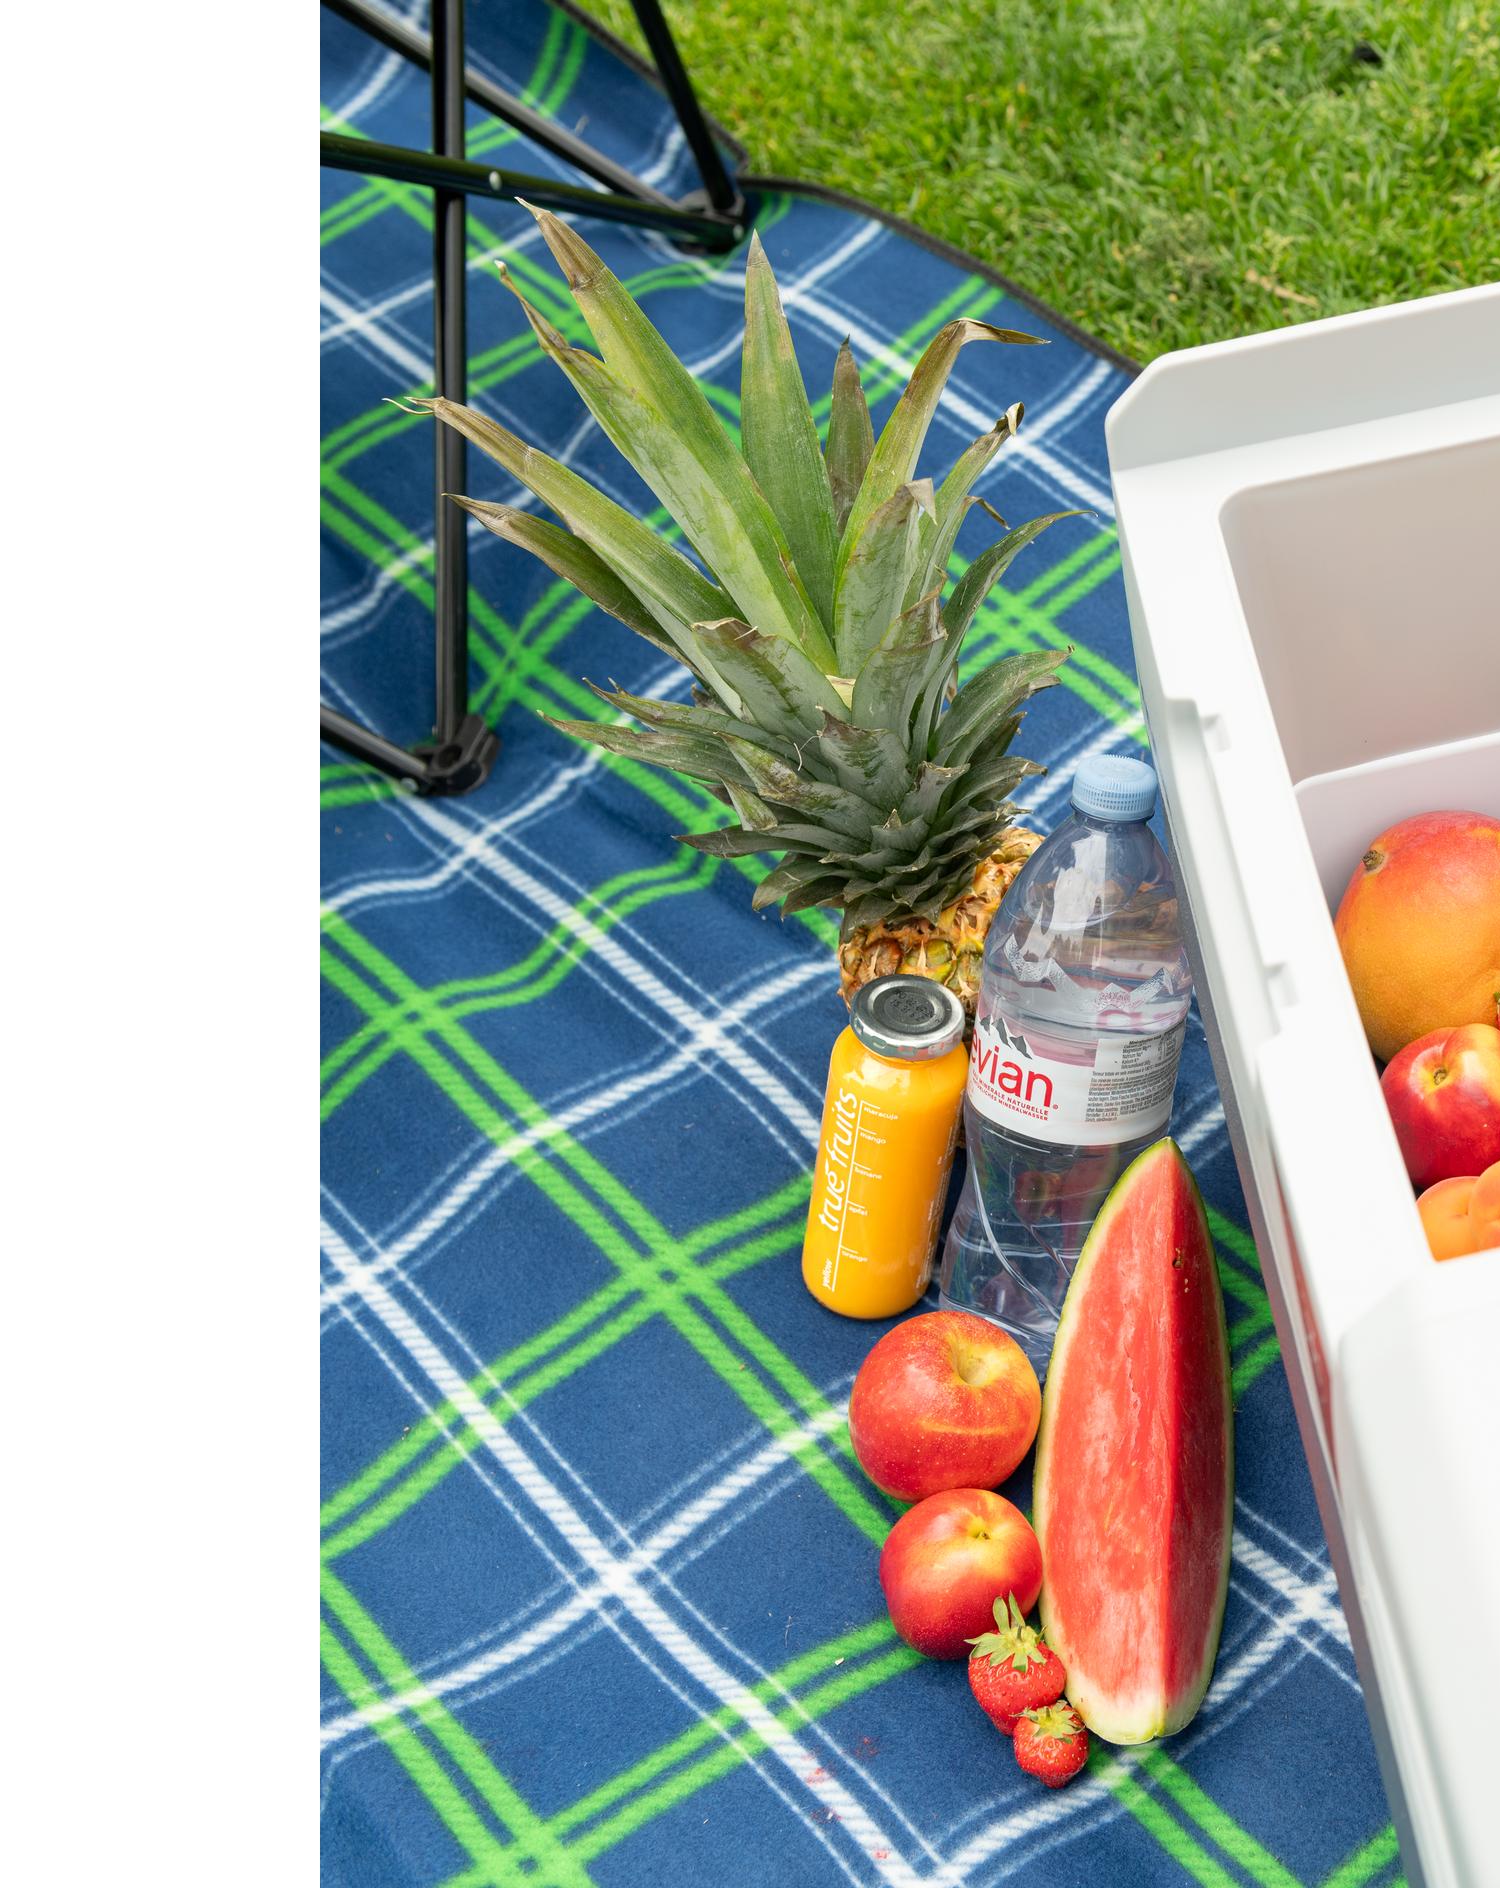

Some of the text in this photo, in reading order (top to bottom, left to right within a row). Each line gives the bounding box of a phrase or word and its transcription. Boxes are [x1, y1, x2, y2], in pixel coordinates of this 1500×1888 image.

[972, 1027, 1053, 1108] evian
[863, 1107, 899, 1120] maracuja
[999, 1100, 1048, 1121] MINERALWASSER
[1007, 1096, 1049, 1116] NATURELLE
[860, 1132, 887, 1145] mango
[818, 1088, 857, 1232] true fruits
[848, 1206, 868, 1217] apfel
[822, 1258, 834, 1290] yellow
